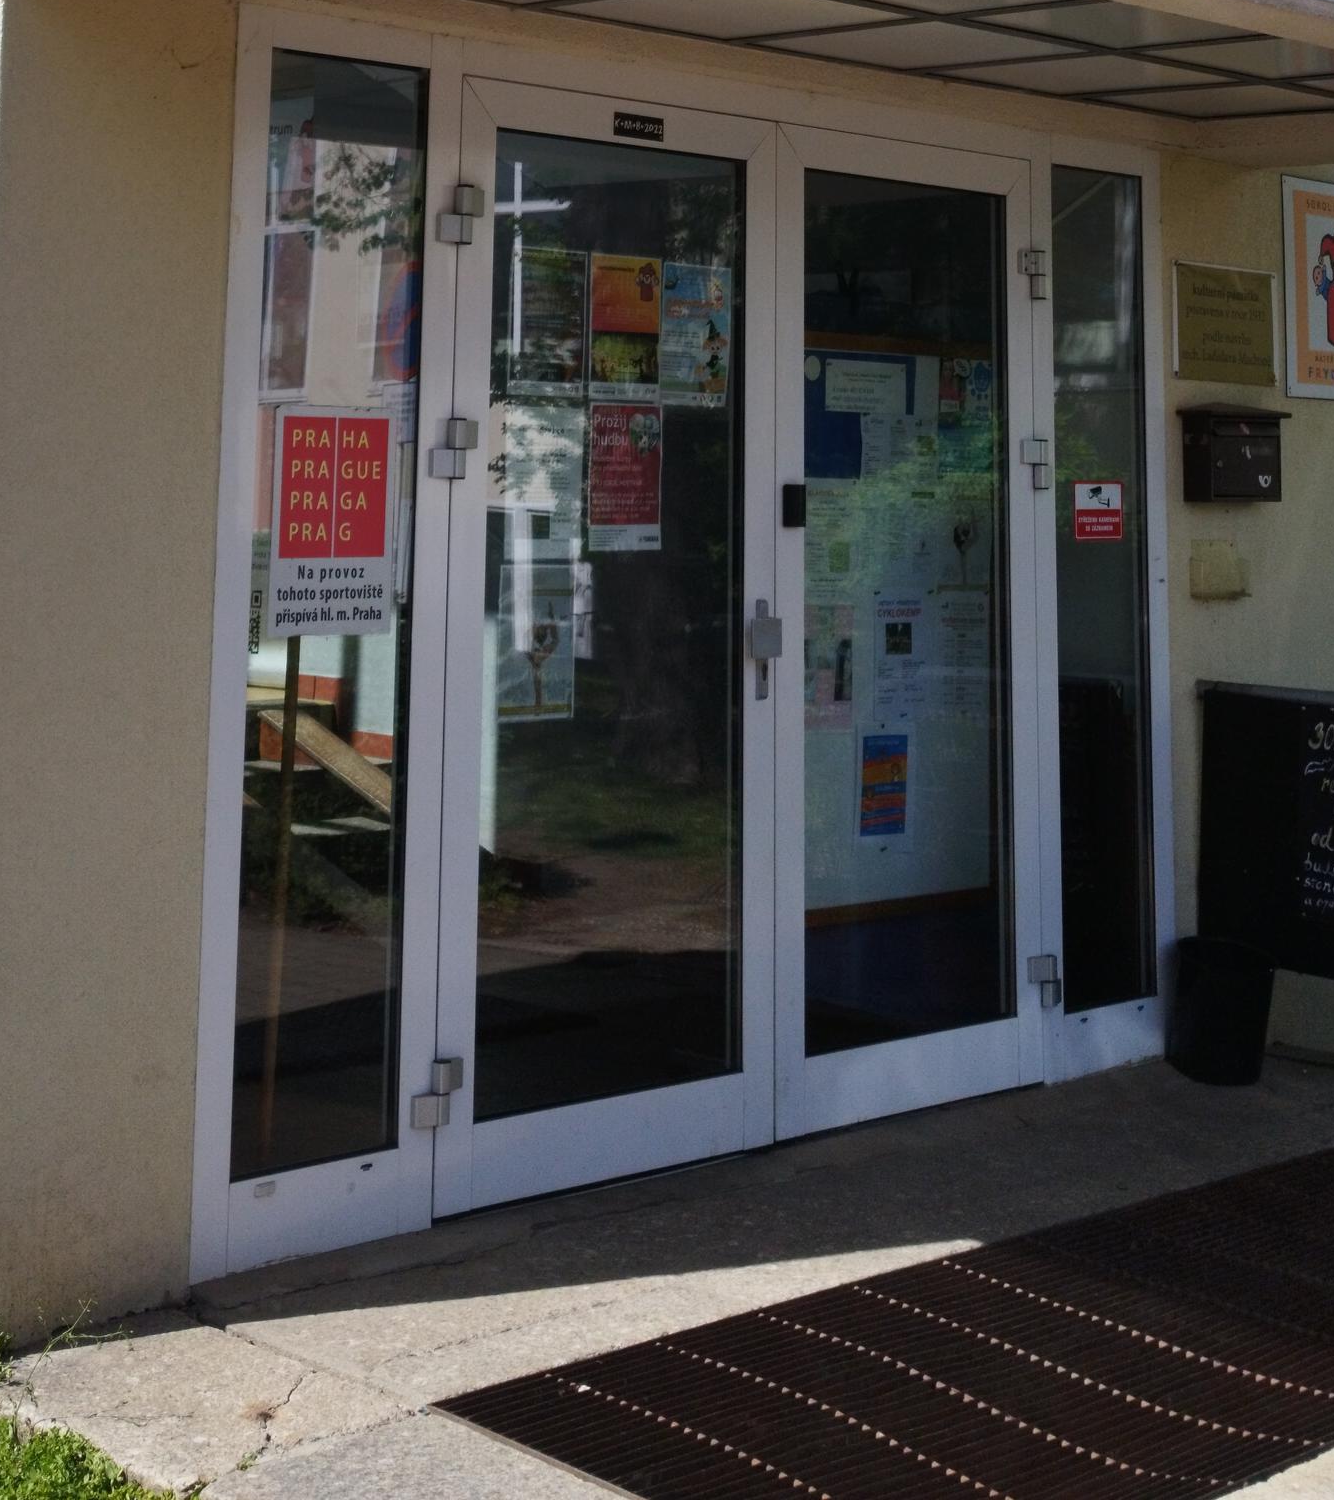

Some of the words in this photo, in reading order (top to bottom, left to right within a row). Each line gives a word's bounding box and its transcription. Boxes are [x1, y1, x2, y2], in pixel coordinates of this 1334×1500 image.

[593, 433, 629, 447] hudbu
[297, 565, 314, 580] Na
[319, 566, 365, 583] provoz
[276, 587, 317, 602] tohoto
[319, 584, 383, 603] sportoviště
[275, 609, 318, 628] přispívá
[320, 608, 334, 622] hl.
[336, 610, 350, 621] m.
[352, 606, 382, 621] Praha
[1310, 826, 1334, 852] od
